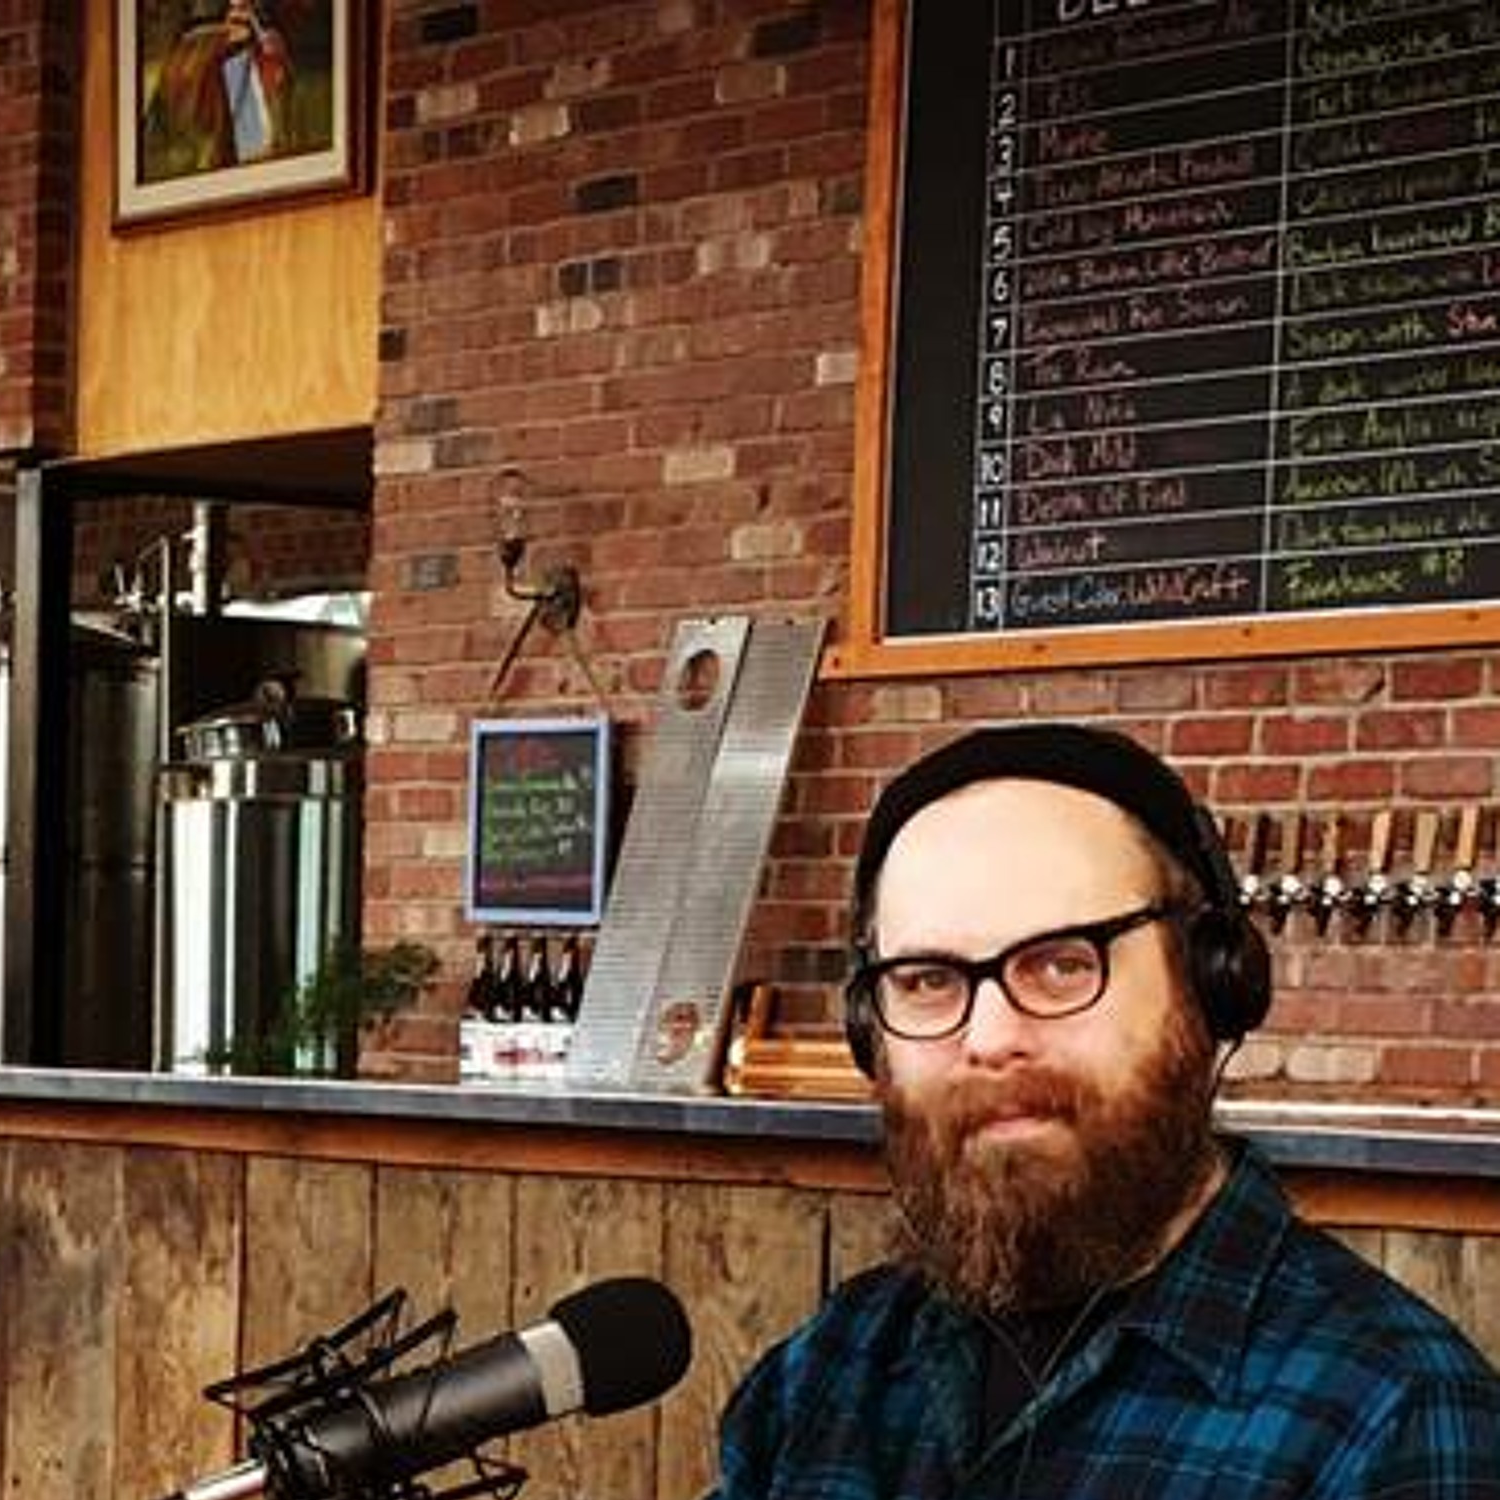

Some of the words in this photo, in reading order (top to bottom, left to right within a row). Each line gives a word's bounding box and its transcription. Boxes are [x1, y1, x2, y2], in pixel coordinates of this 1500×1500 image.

[999, 92, 1017, 126] 2
[997, 134, 1014, 176] 3
[992, 224, 1012, 262] 5
[992, 271, 1010, 302] 6
[989, 320, 1009, 348] 7
[987, 361, 1006, 398] 8
[987, 403, 1004, 434] 9
[979, 453, 1005, 482] 10
[979, 493, 1001, 526] 11
[976, 538, 1003, 571] 12
[975, 585, 1001, 620] 13
